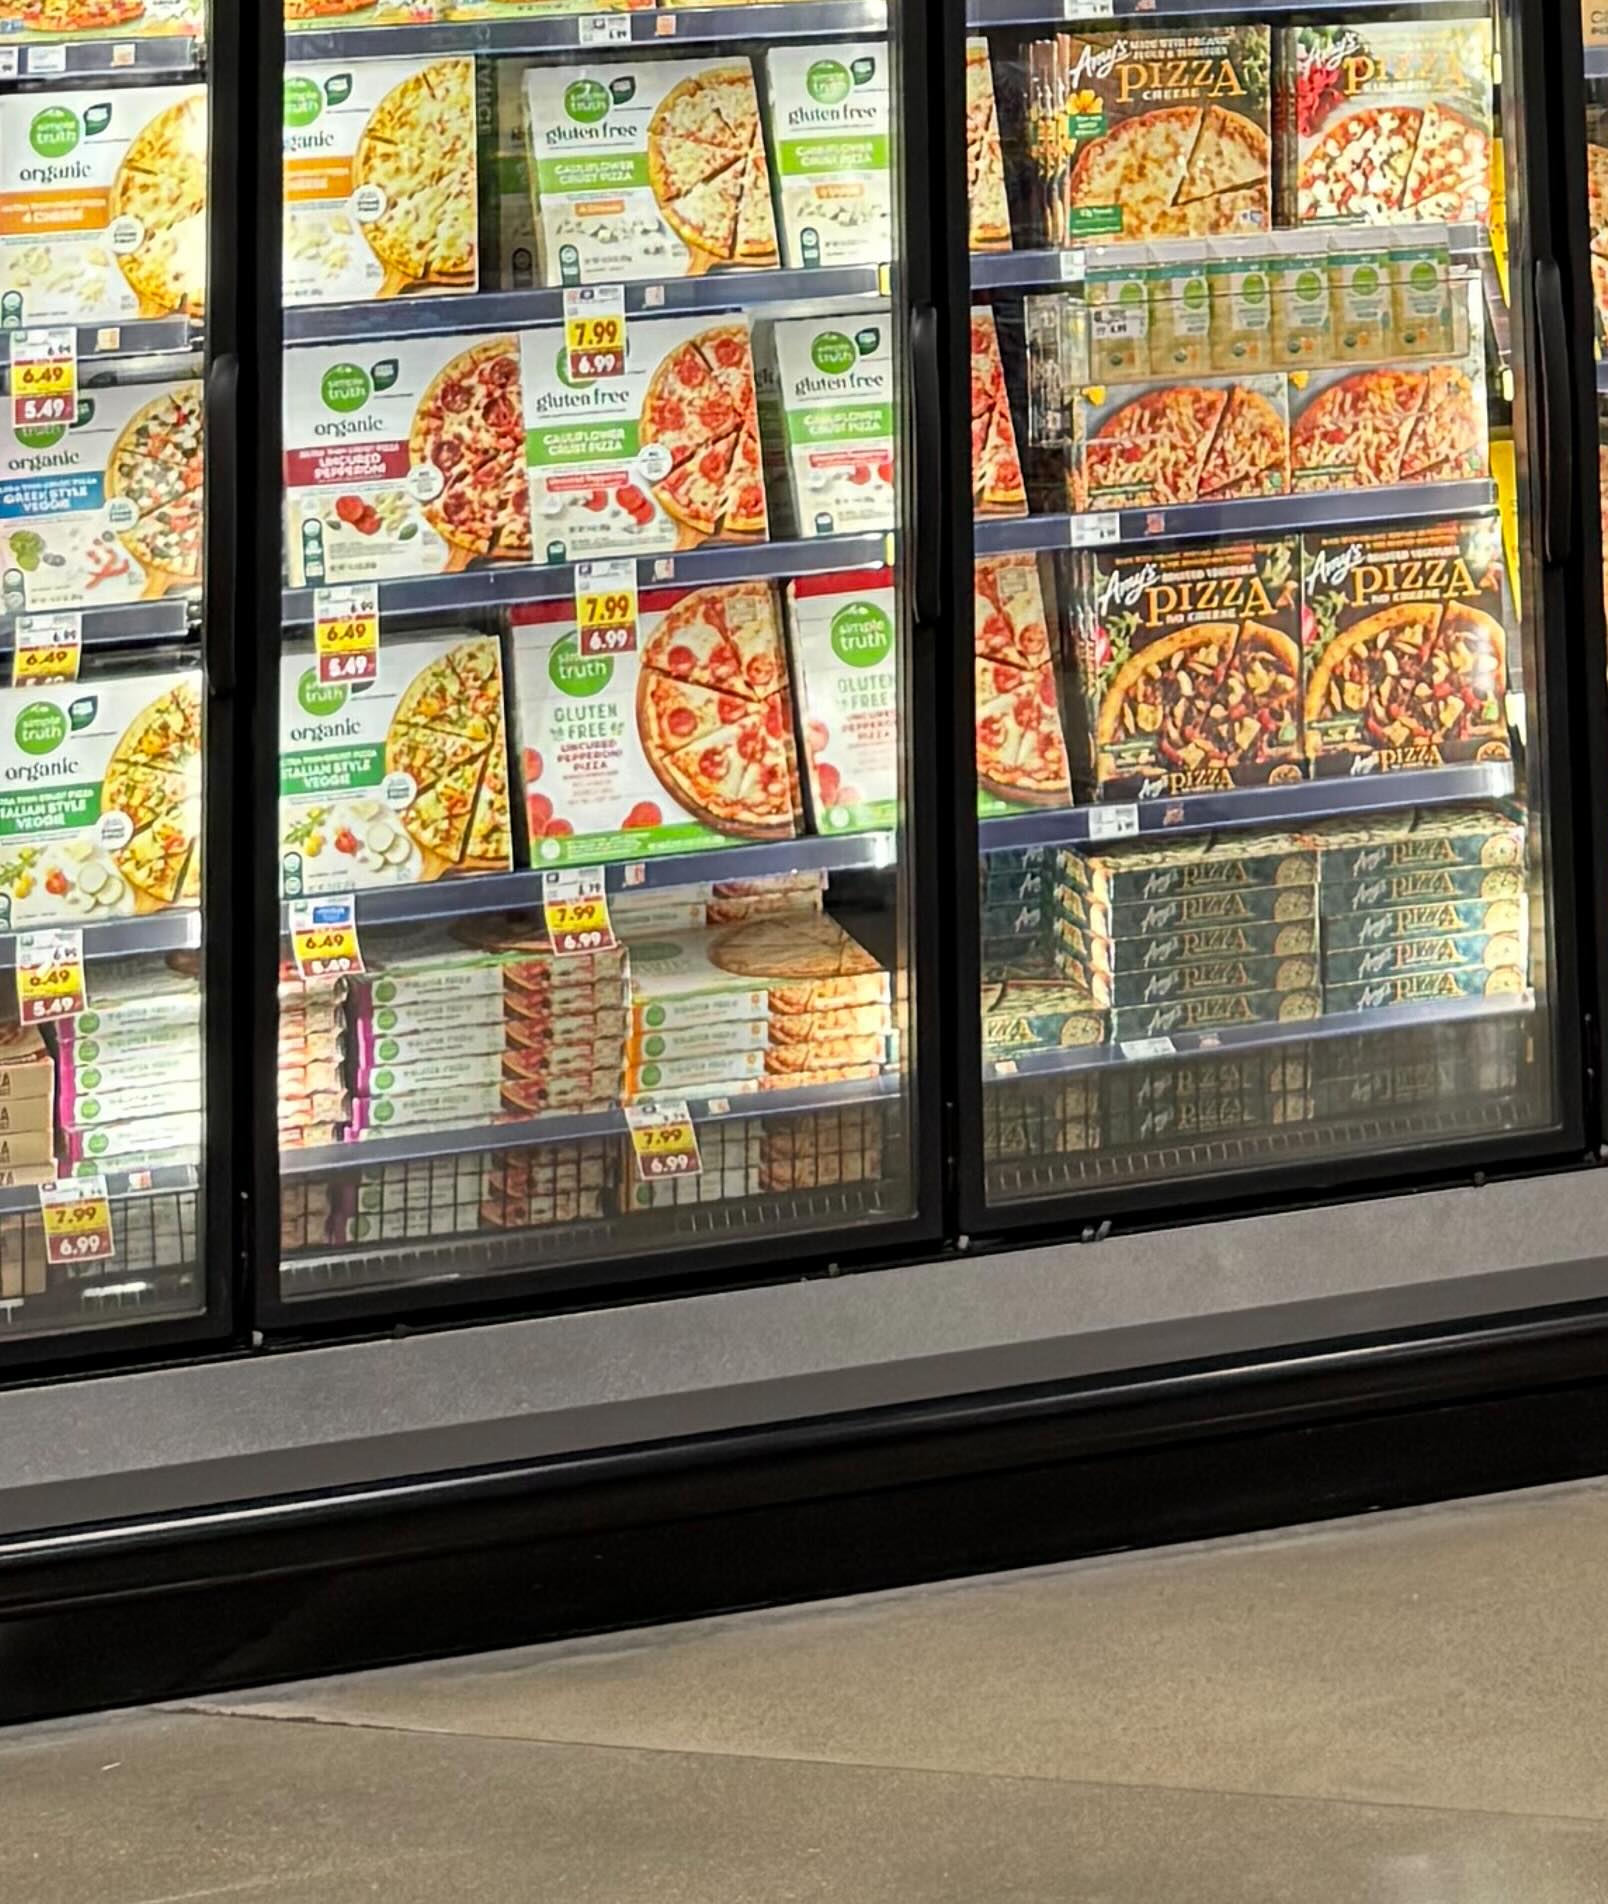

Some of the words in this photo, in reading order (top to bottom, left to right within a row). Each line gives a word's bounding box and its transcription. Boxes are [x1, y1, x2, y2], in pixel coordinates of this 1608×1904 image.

[1070, 40, 1131, 89] Amy's
[1343, 50, 1472, 96] PIZZA
[1115, 59, 1248, 103] PIZZA
[1142, 88, 1199, 101] CHEESE
[788, 105, 839, 125] gluten
[843, 104, 878, 120] free
[36, 131, 77, 145] truth
[545, 125, 598, 145] gluten
[602, 123, 638, 139] free
[19, 161, 92, 183] organic
[573, 320, 617, 344] 7.99
[577, 353, 616, 373] 6.99
[23, 367, 64, 384] 6.49
[795, 374, 848, 395] gluten
[850, 371, 884, 389] free
[328, 389, 366, 400] truth
[535, 391, 590, 413] gluten
[594, 388, 630, 405] free
[24, 399, 65, 418] 5.49
[314, 415, 384, 437] organic
[8, 450, 80, 472] organic
[319, 453, 381, 467] UNCURED
[1305, 544, 1366, 595] Amy's
[1098, 564, 1160, 616] Amy's
[1351, 558, 1482, 607] PIZZA
[586, 595, 629, 622] 7.99
[1145, 577, 1278, 628] PIZZA
[326, 624, 366, 642] 6.49
[840, 621, 885, 636] simple
[589, 629, 629, 650] 6.99
[840, 632, 888, 651] truth
[25, 651, 68, 666] 6.49
[328, 657, 368, 677] 5.49
[559, 661, 608, 680] truth
[305, 689, 344, 703] truth
[850, 693, 888, 710] FREE
[553, 704, 618, 722] GLUTEN
[22, 728, 63, 741] truth
[290, 718, 361, 742] organic
[568, 721, 609, 740] FREE
[560, 738, 617, 752] UNCURED
[557, 750, 623, 764] PEPPERONI
[573, 760, 608, 771] PIZZA
[1379, 744, 1443, 770] PIZZA
[5, 757, 79, 780] organic
[1168, 768, 1236, 795] PIZZA
[1389, 840, 1459, 868] PIZZA
[1181, 862, 1252, 889] PIZZA
[1390, 871, 1459, 902] PIZZA
[556, 906, 595, 922] 7.99
[1177, 895, 1252, 924] PIZZA
[1395, 903, 1465, 935] PIZZA
[305, 934, 344, 949] 6.49
[564, 932, 601, 950] 6.99
[1178, 927, 1253, 958] PIZZA
[1394, 938, 1464, 970] PIZZA
[1179, 963, 1253, 993] PIZZA
[1393, 972, 1463, 1004] PIZZA
[32, 996, 74, 1017] 5.49
[1183, 996, 1258, 1027] PIZZA
[643, 1129, 682, 1145] 7.99
[650, 1155, 688, 1173] 6.99
[55, 1206, 97, 1224] 7.99
[59, 1234, 101, 1256] 6.99
